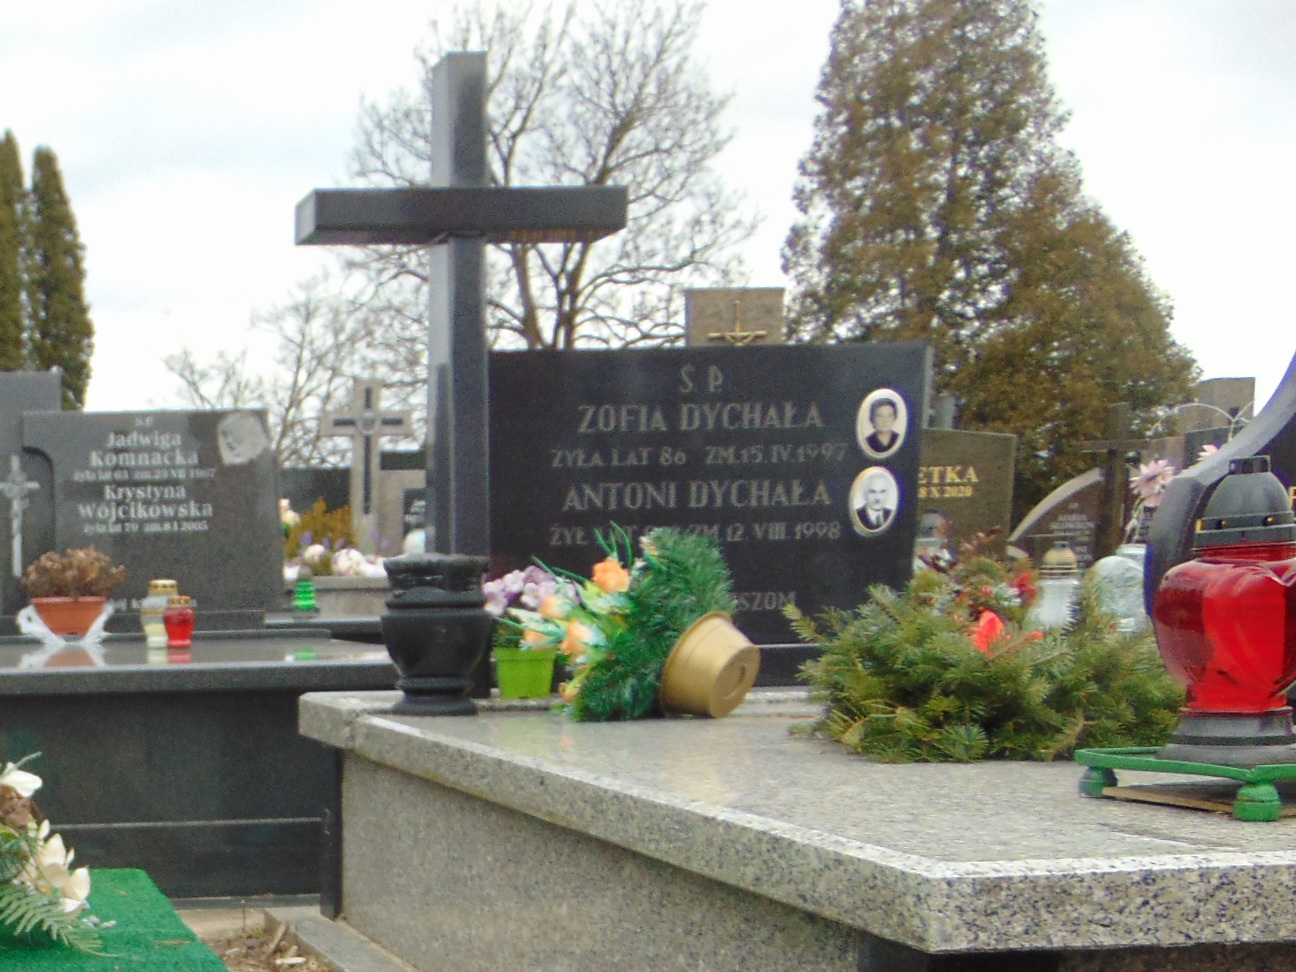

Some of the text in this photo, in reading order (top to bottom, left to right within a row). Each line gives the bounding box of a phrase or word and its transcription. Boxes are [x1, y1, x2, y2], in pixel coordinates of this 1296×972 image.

[576, 400, 826, 434] ZOFIA DYCHAŁA
[105, 431, 182, 449] Jadwiga
[89, 449, 199, 467] Komnacka
[610, 446, 653, 467] LAT
[917, 465, 980, 484] ETKA
[104, 484, 186, 503] Krystyna
[562, 478, 831, 512] ANTONI DYCHAŁA
